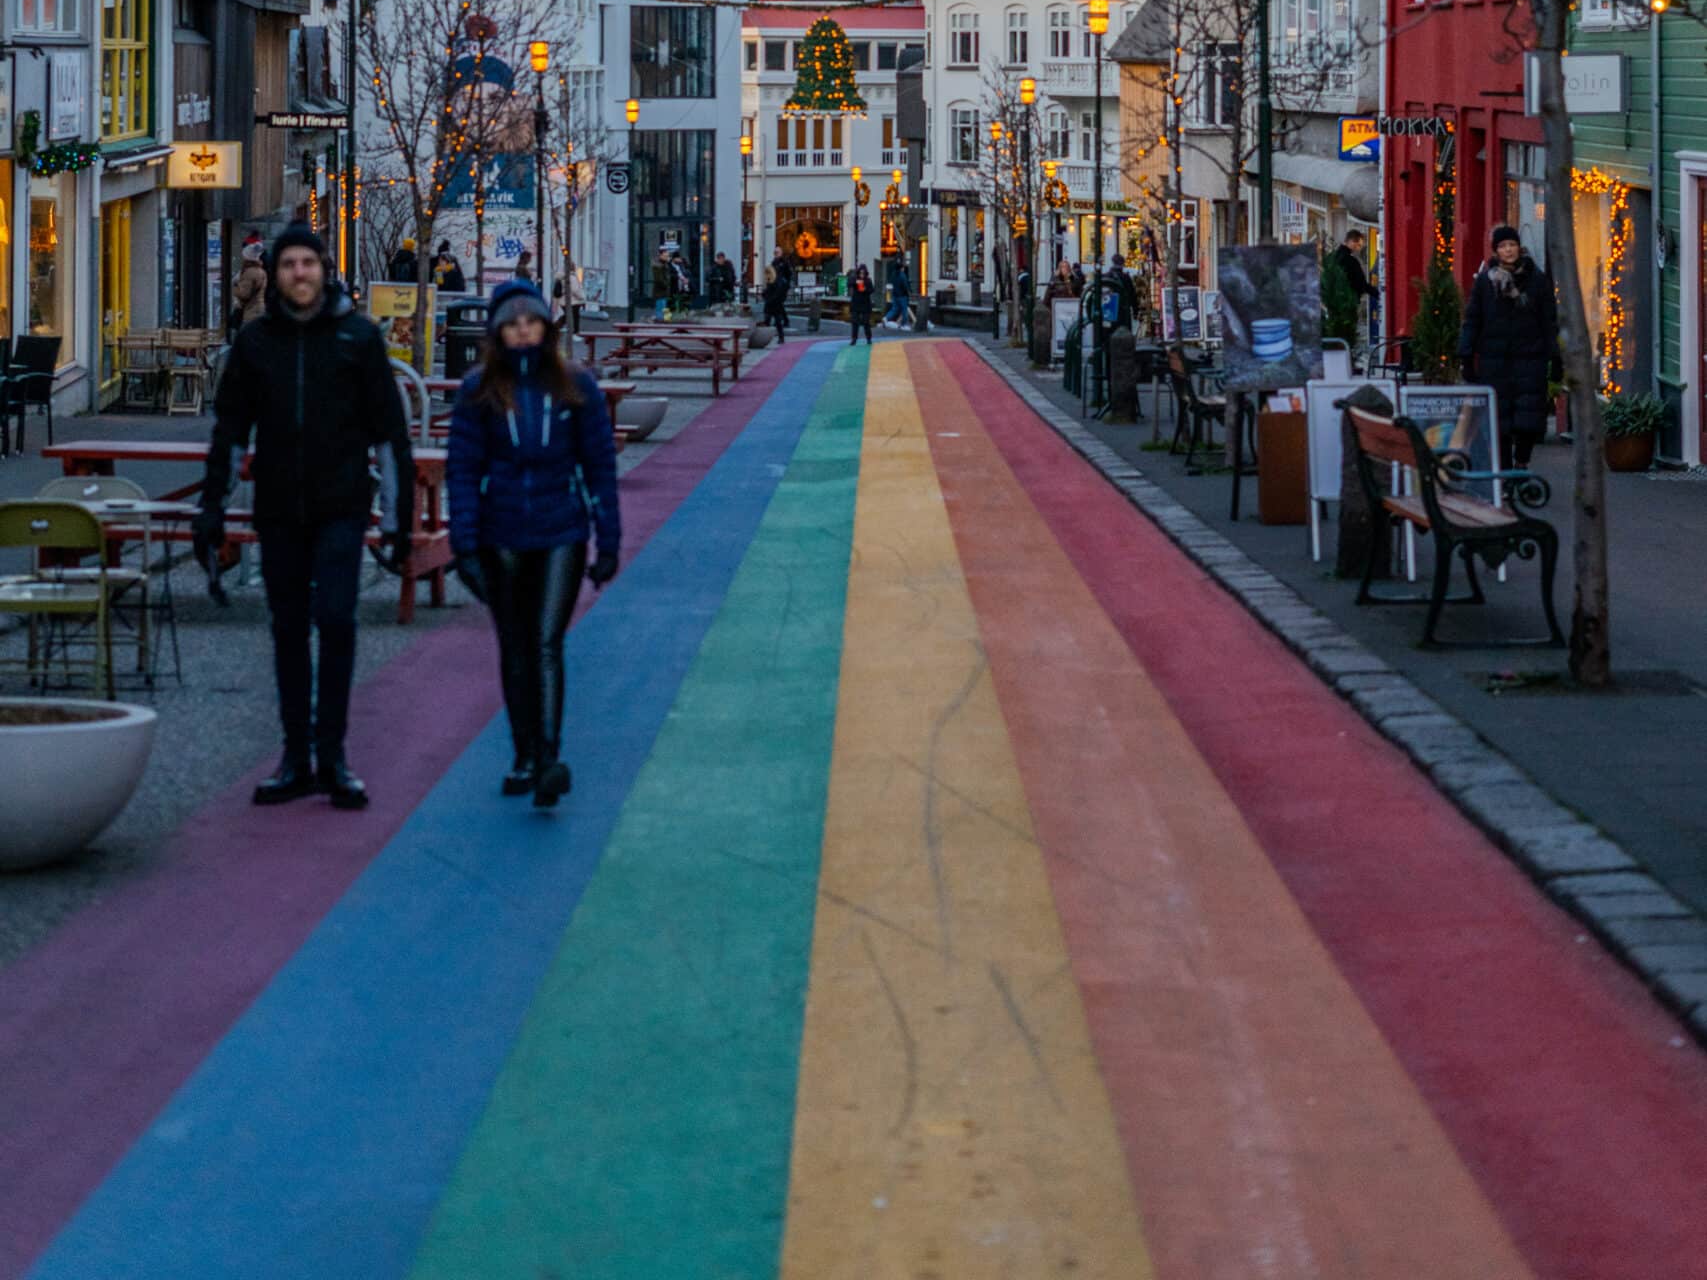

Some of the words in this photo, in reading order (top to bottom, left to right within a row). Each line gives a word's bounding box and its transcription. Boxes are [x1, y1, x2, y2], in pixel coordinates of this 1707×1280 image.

[1567, 72, 1610, 90] olin
[305, 115, 329, 127] fine
[330, 116, 347, 127] art
[1348, 123, 1375, 133] ATM
[1378, 116, 1447, 137] MOKKA
